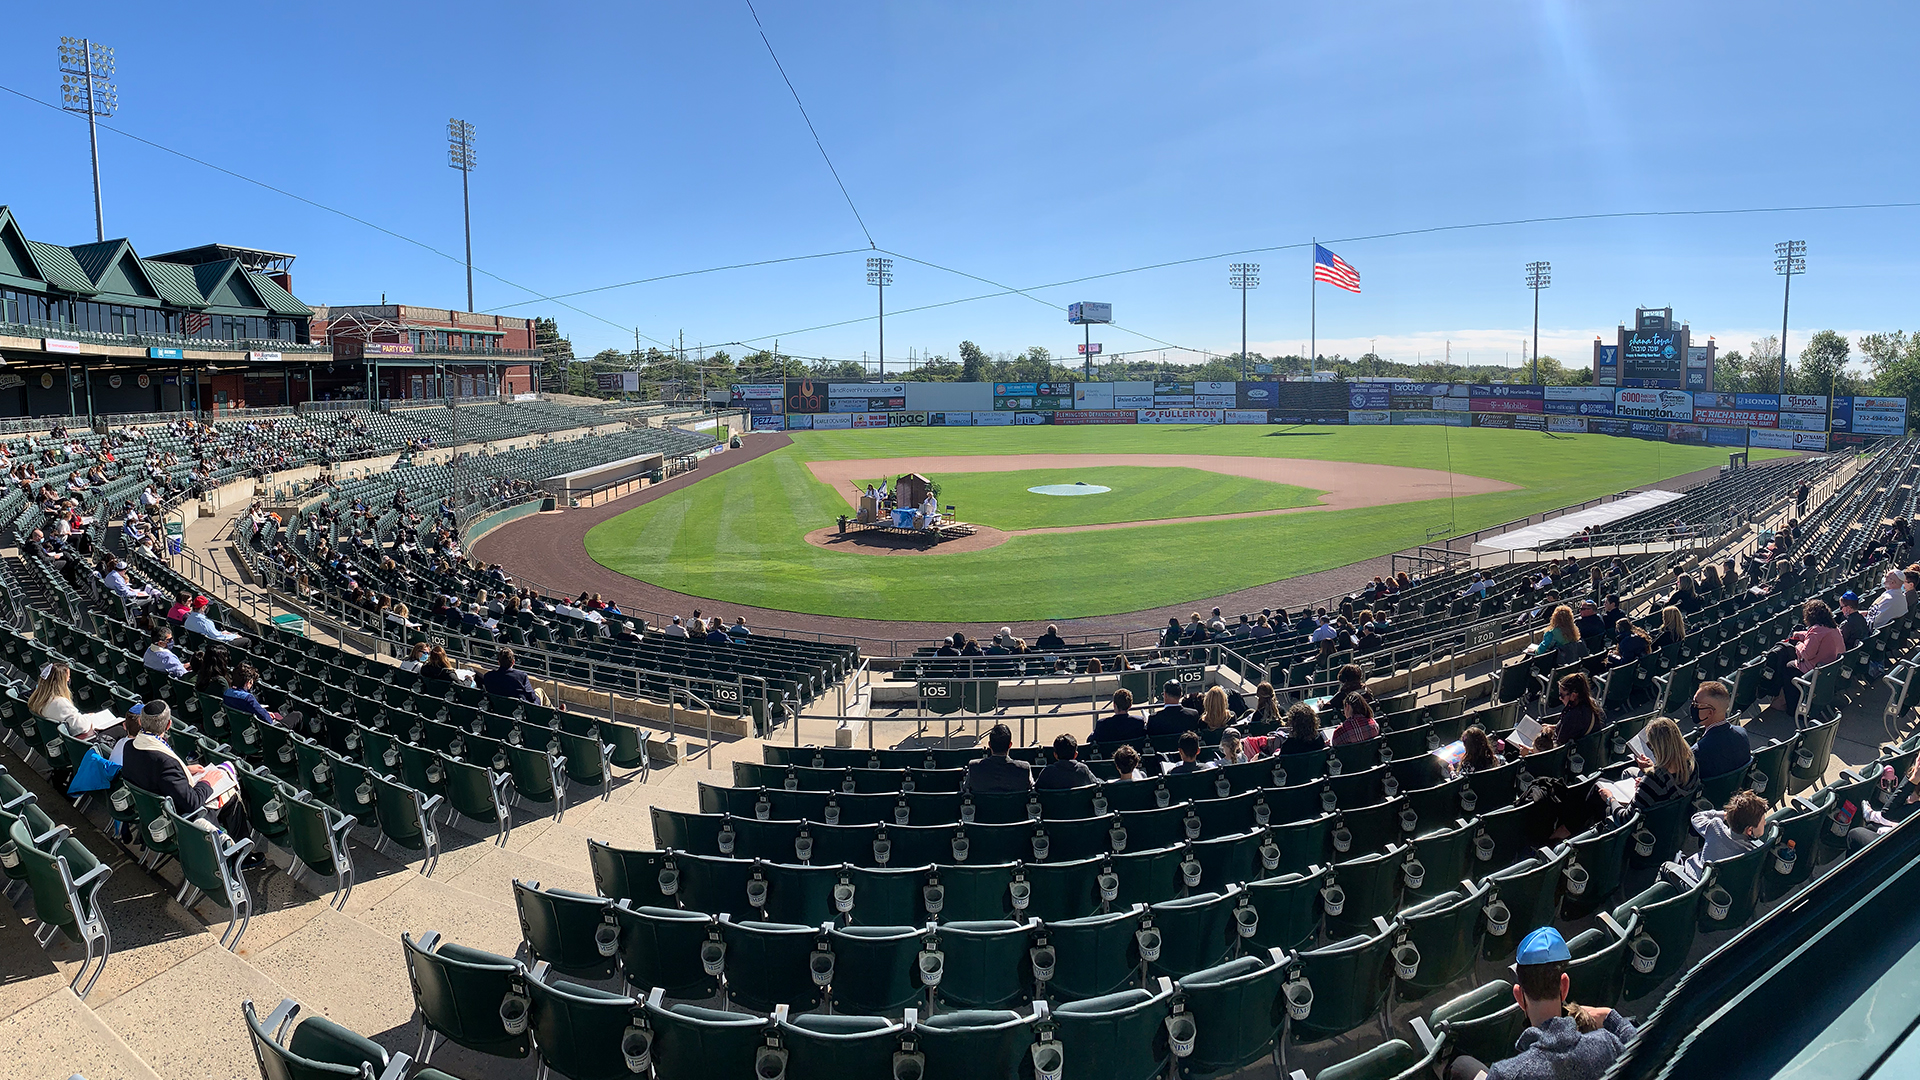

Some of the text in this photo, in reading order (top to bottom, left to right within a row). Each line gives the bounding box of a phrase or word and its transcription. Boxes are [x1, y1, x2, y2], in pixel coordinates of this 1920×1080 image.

[382, 345, 398, 353] PARTY
[399, 345, 414, 353] DECK
[790, 385, 824, 410] char
[1622, 392, 1640, 403] 6000
[1788, 396, 1818, 407] Tirpok
[1056, 411, 1087, 419] FLEMINGTON
[1158, 410, 1217, 418] FULLERTON
[1617, 405, 1692, 419] Flemington.com
[1708, 410, 1751, 420] RICHARD
[1752, 412, 1758, 421] &
[1757, 413, 1778, 422] SON
[888, 413, 924, 427] njpac
[1858, 415, 1900, 423] 732-494-9200
[1632, 423, 1664, 433] SUPERCUTS
[431, 636, 446, 645] 103
[1473, 631, 1495, 645] IZOD
[1179, 671, 1202, 682] 105
[716, 689, 738, 700] 103
[922, 686, 947, 696] 105
[91, 926, 98, 934] R
